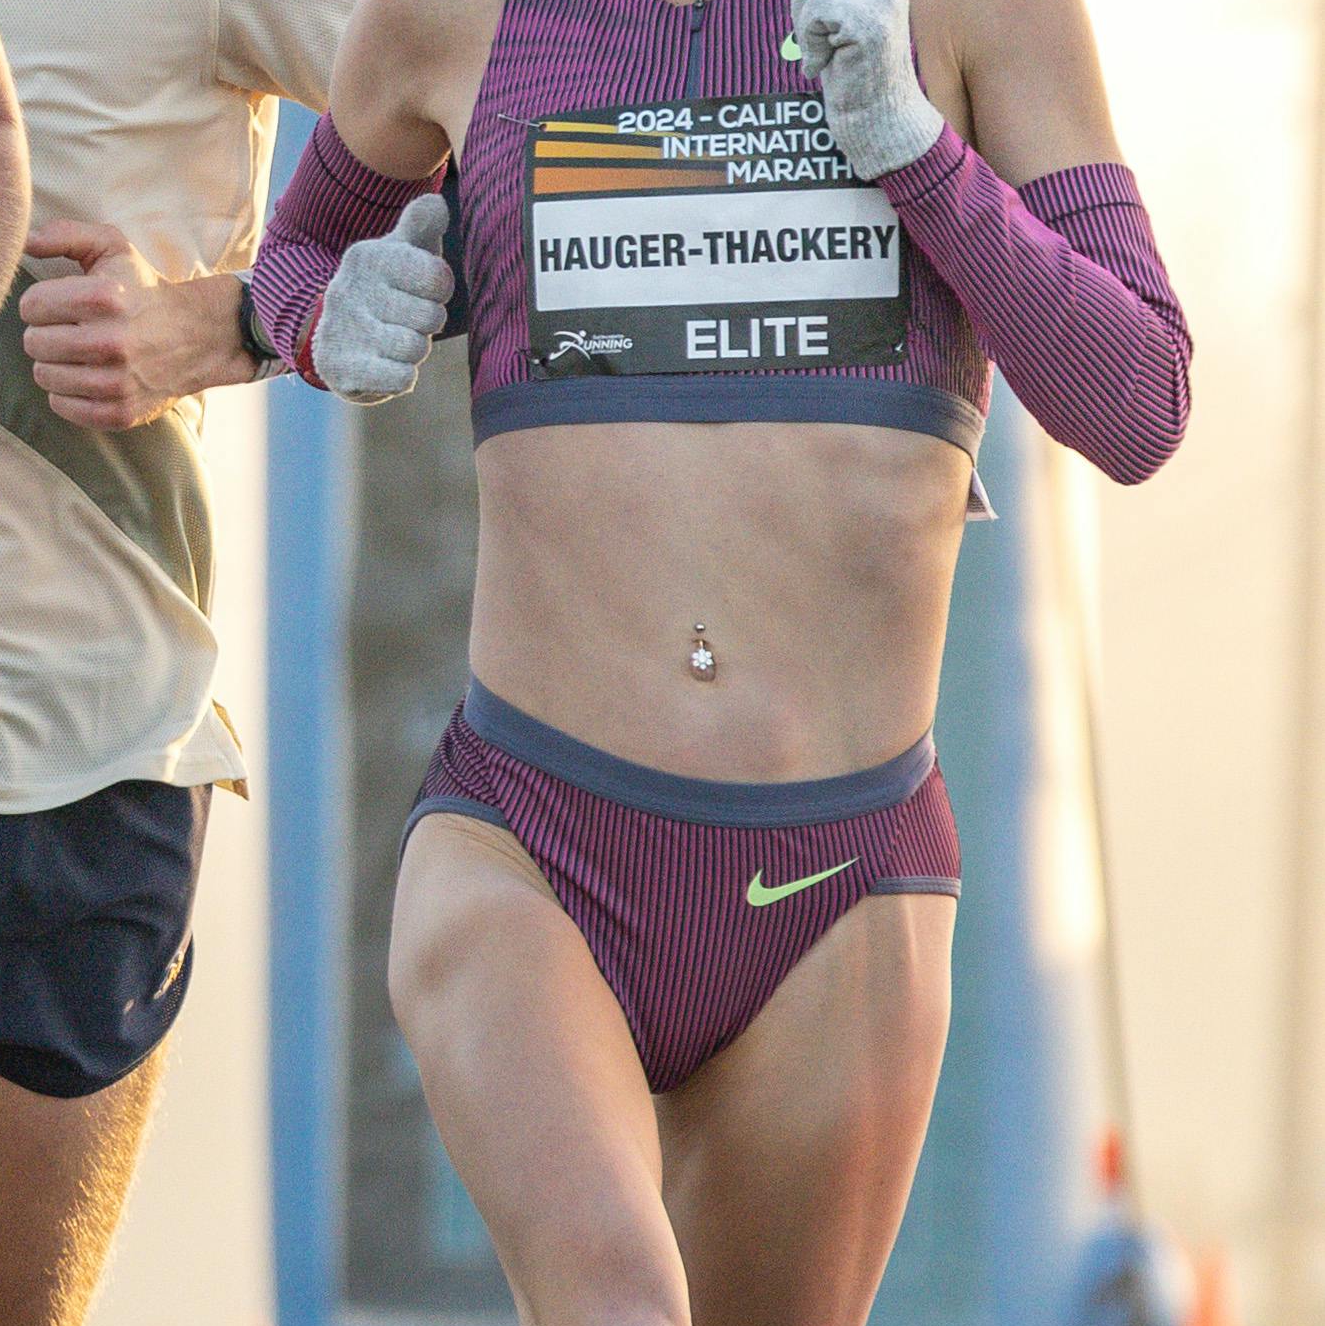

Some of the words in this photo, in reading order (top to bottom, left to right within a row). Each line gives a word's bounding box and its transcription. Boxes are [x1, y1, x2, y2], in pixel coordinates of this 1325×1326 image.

[617, 107, 695, 134] 2024
[717, 100, 824, 129] CALIFO
[661, 128, 836, 160] INTERNATIO
[726, 157, 853, 185] MARATH
[539, 224, 897, 273] HAUGER-THACKERY
[686, 315, 830, 360] ELITE
